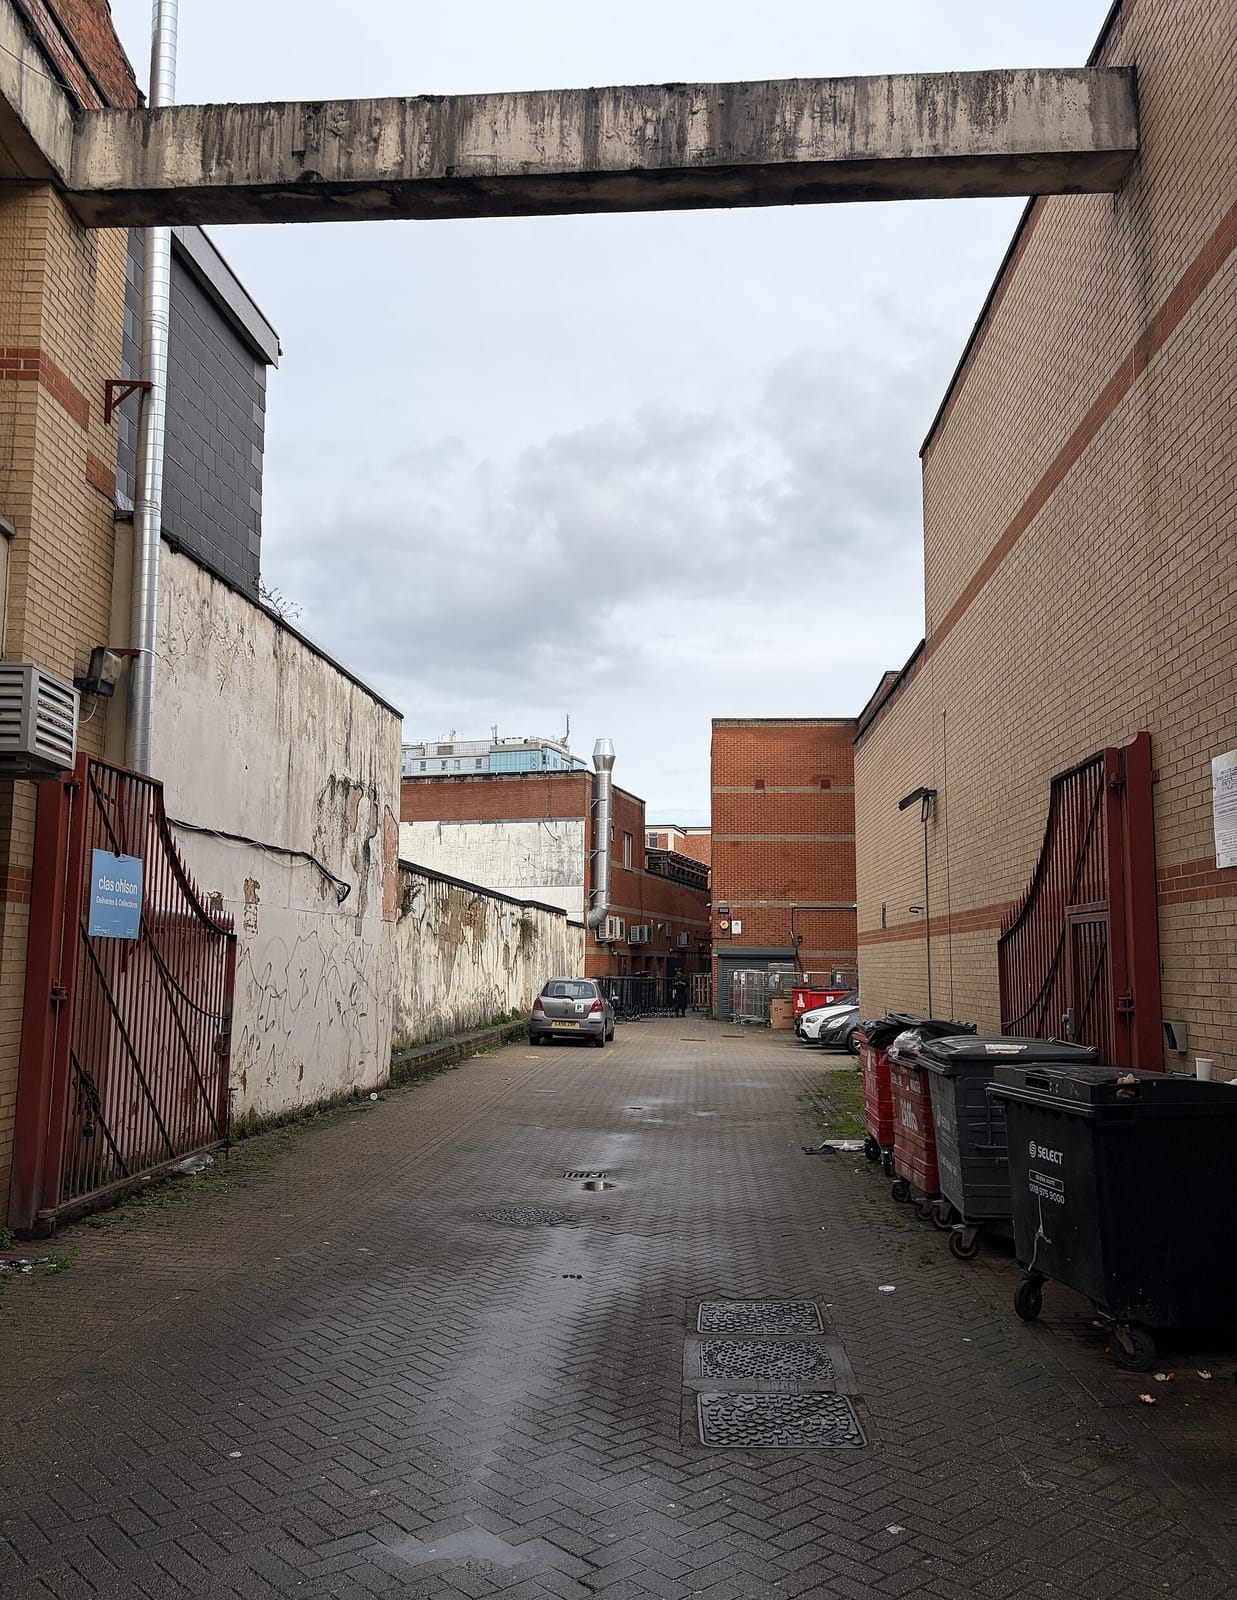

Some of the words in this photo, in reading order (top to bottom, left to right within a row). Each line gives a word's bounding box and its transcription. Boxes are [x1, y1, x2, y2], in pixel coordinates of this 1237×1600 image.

[98, 875, 114, 891] clas
[115, 878, 138, 896] ohlson
[1037, 1146, 1063, 1165] SELECT
